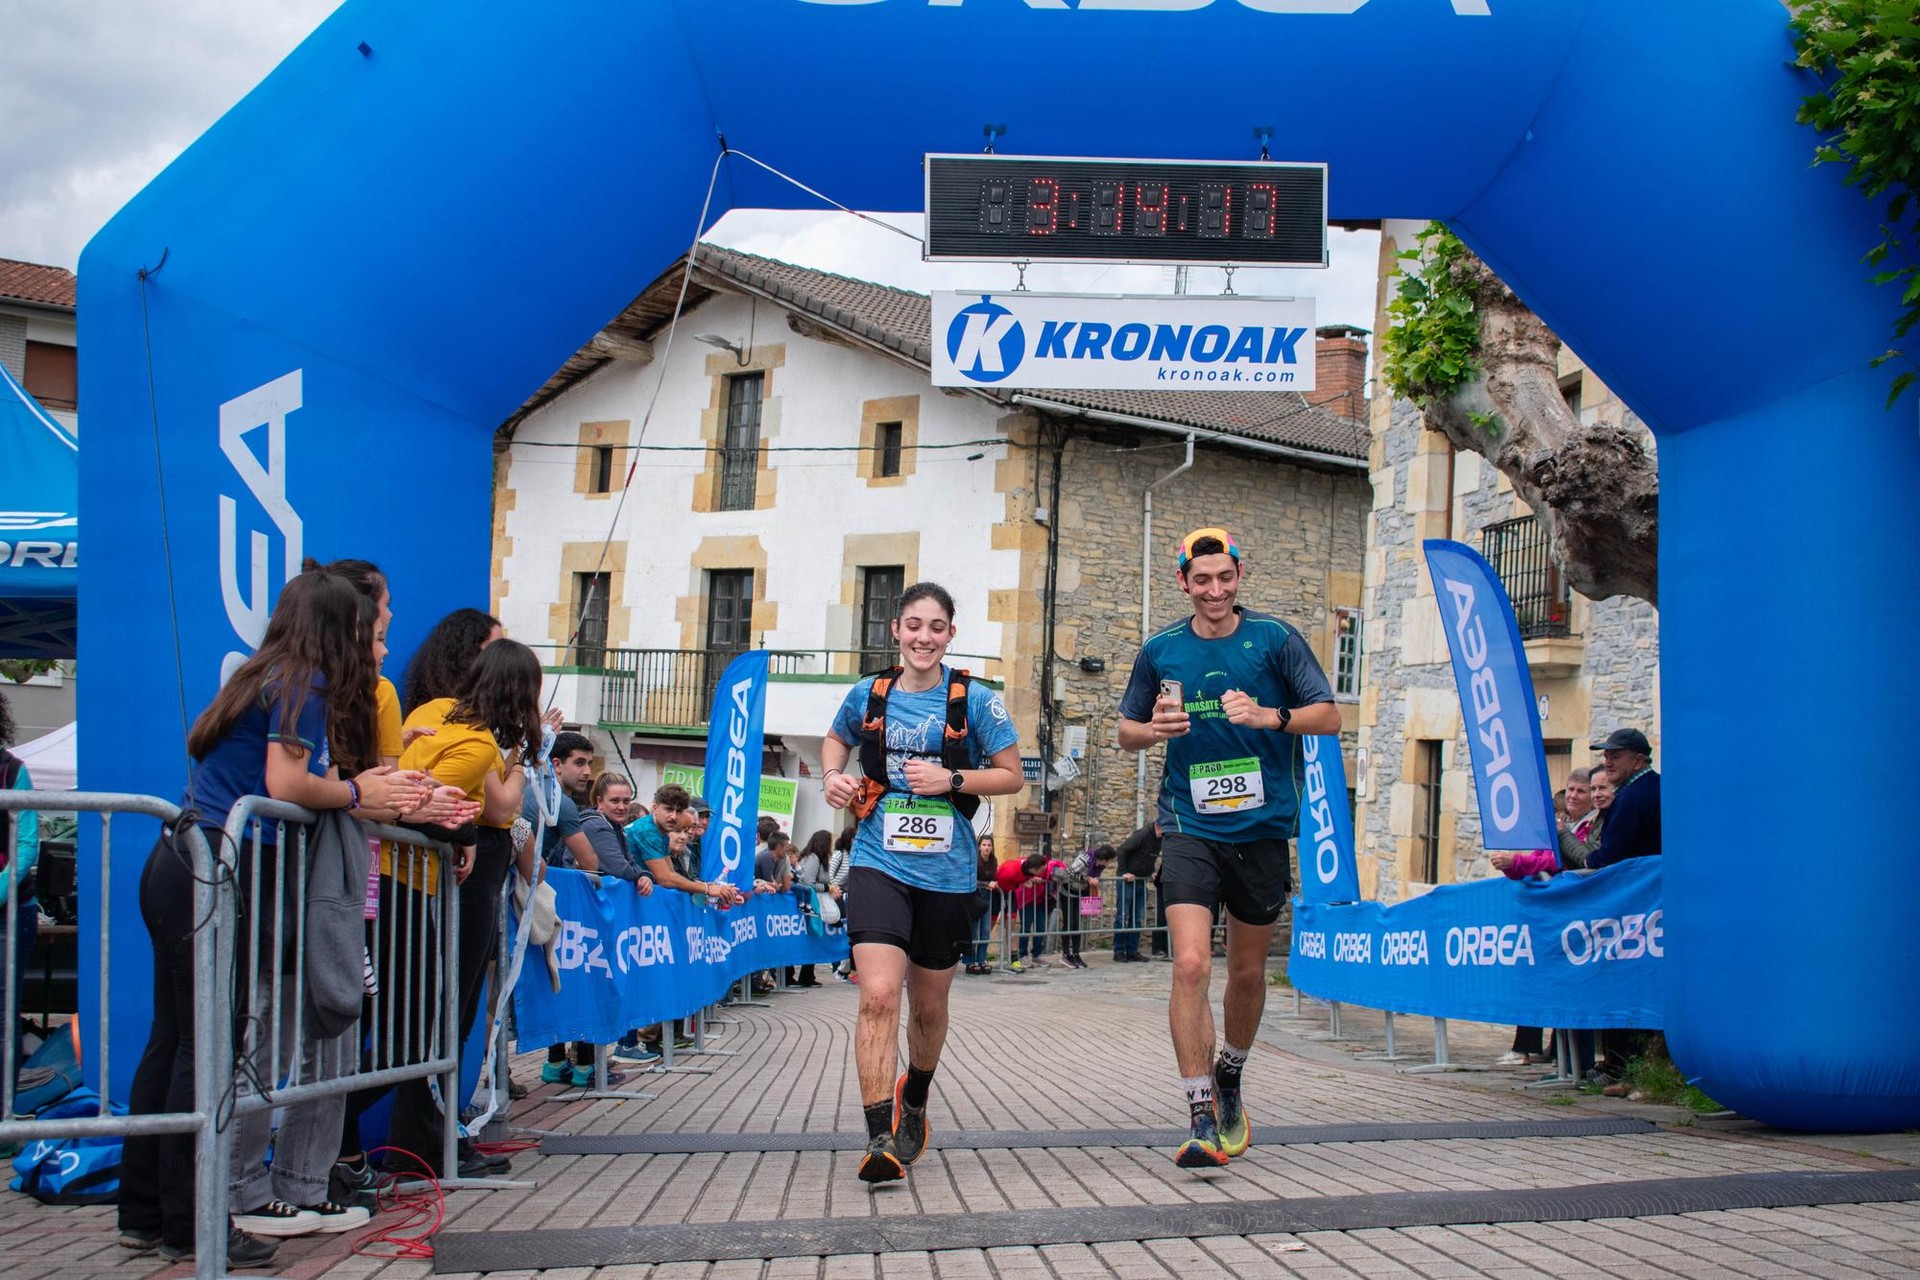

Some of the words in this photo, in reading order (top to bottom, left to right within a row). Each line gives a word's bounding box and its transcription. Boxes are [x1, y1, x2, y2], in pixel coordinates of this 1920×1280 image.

[1027, 178, 1276, 236] 3:14:17
[1034, 320, 1308, 364] KRONOAK
[1157, 366, 1295, 384] kronoak.com
[721, 677, 752, 871] ORBEA
[1207, 776, 1247, 796] 298
[898, 816, 937, 835] 286
[766, 914, 808, 937] ORBEA
[1299, 930, 1326, 960] ORBEA
[1333, 932, 1371, 964] ORBEA
[1381, 929, 1429, 966] ORBEA
[1445, 924, 1535, 966] ORBEA
